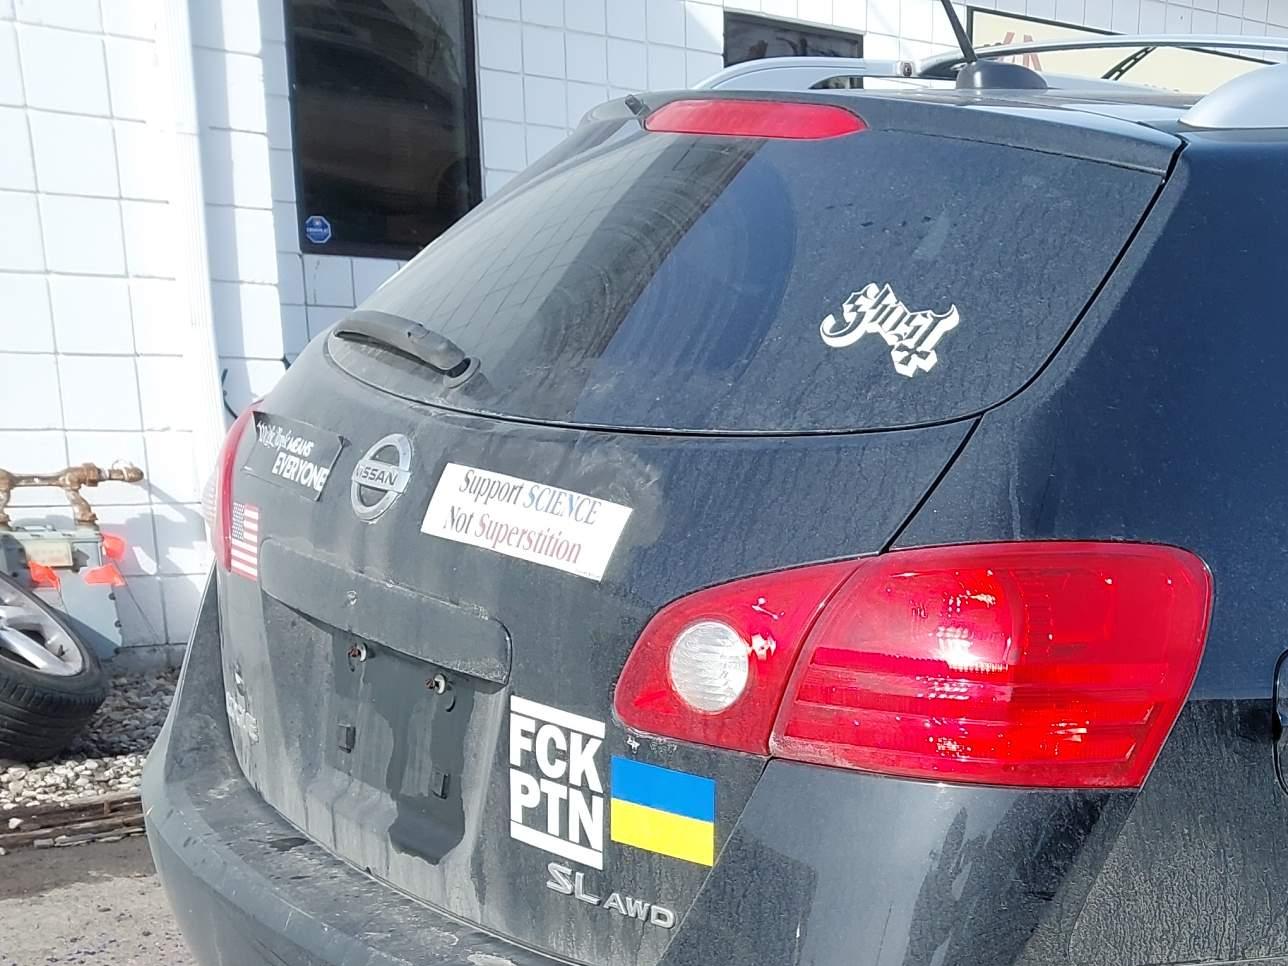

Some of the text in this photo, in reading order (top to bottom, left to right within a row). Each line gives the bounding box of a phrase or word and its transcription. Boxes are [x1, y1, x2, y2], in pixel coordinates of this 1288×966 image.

[272, 452, 330, 492] EVERYONE
[286, 436, 315, 457] MEANS
[356, 464, 399, 486] NISSAN
[459, 469, 602, 525] Support SCIENCE
[443, 505, 582, 564] Not Superstition
[510, 712, 604, 793] FCK
[510, 768, 604, 852] PTN
[547, 862, 676, 929] SL AWD
